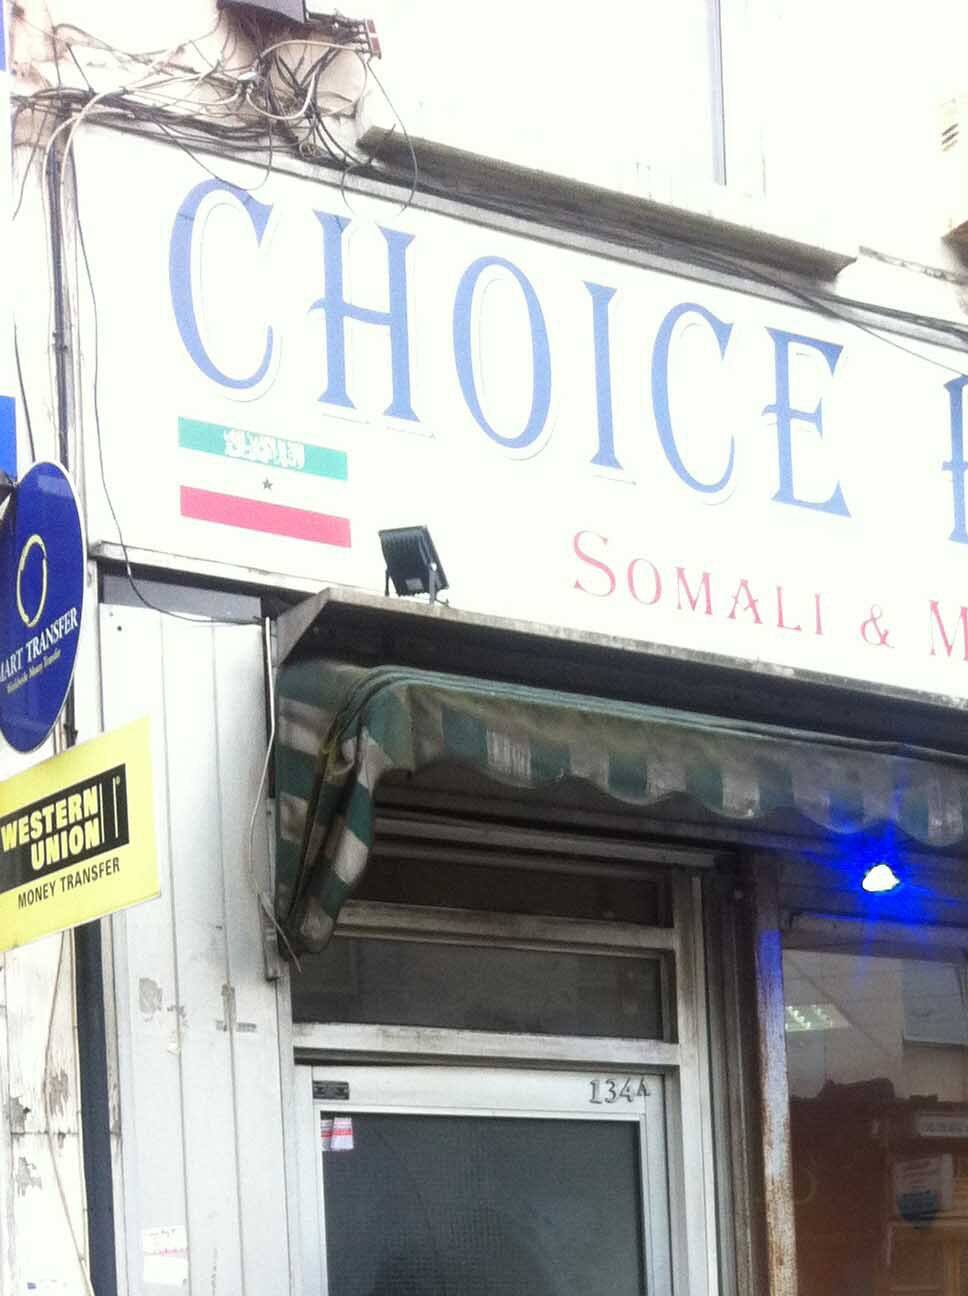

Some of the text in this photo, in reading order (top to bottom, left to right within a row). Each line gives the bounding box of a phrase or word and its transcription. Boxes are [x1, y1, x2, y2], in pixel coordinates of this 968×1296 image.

[170, 180, 851, 518] CHOICE
[573, 531, 824, 636] SOMALI
[860, 604, 893, 650] &
[26, 607, 78, 662] TRANSFER
[0, 784, 99, 851] WESTERN
[30, 816, 101, 871] UNION
[17, 857, 120, 910] MONEY TRANSFER
[589, 1076, 651, 1105] 134A
